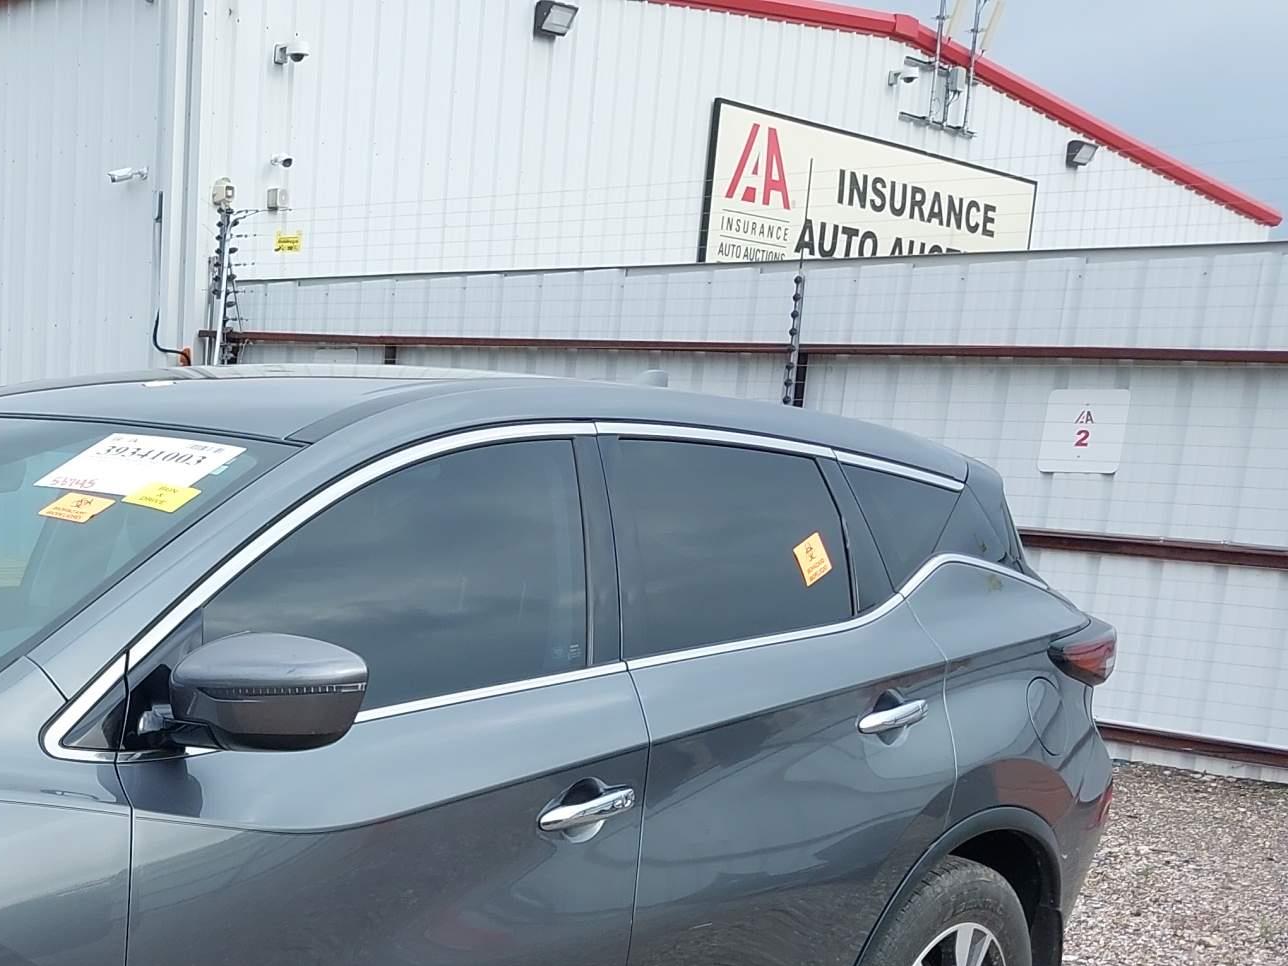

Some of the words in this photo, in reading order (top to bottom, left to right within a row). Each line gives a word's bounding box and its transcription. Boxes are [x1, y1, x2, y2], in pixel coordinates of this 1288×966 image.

[837, 168, 996, 238] INSURANCE
[720, 215, 789, 241] INSURANCE
[794, 218, 878, 258] AUTO
[717, 242, 742, 259] AUTO
[1074, 429, 1090, 447] 2
[96, 445, 207, 465] 39341003
